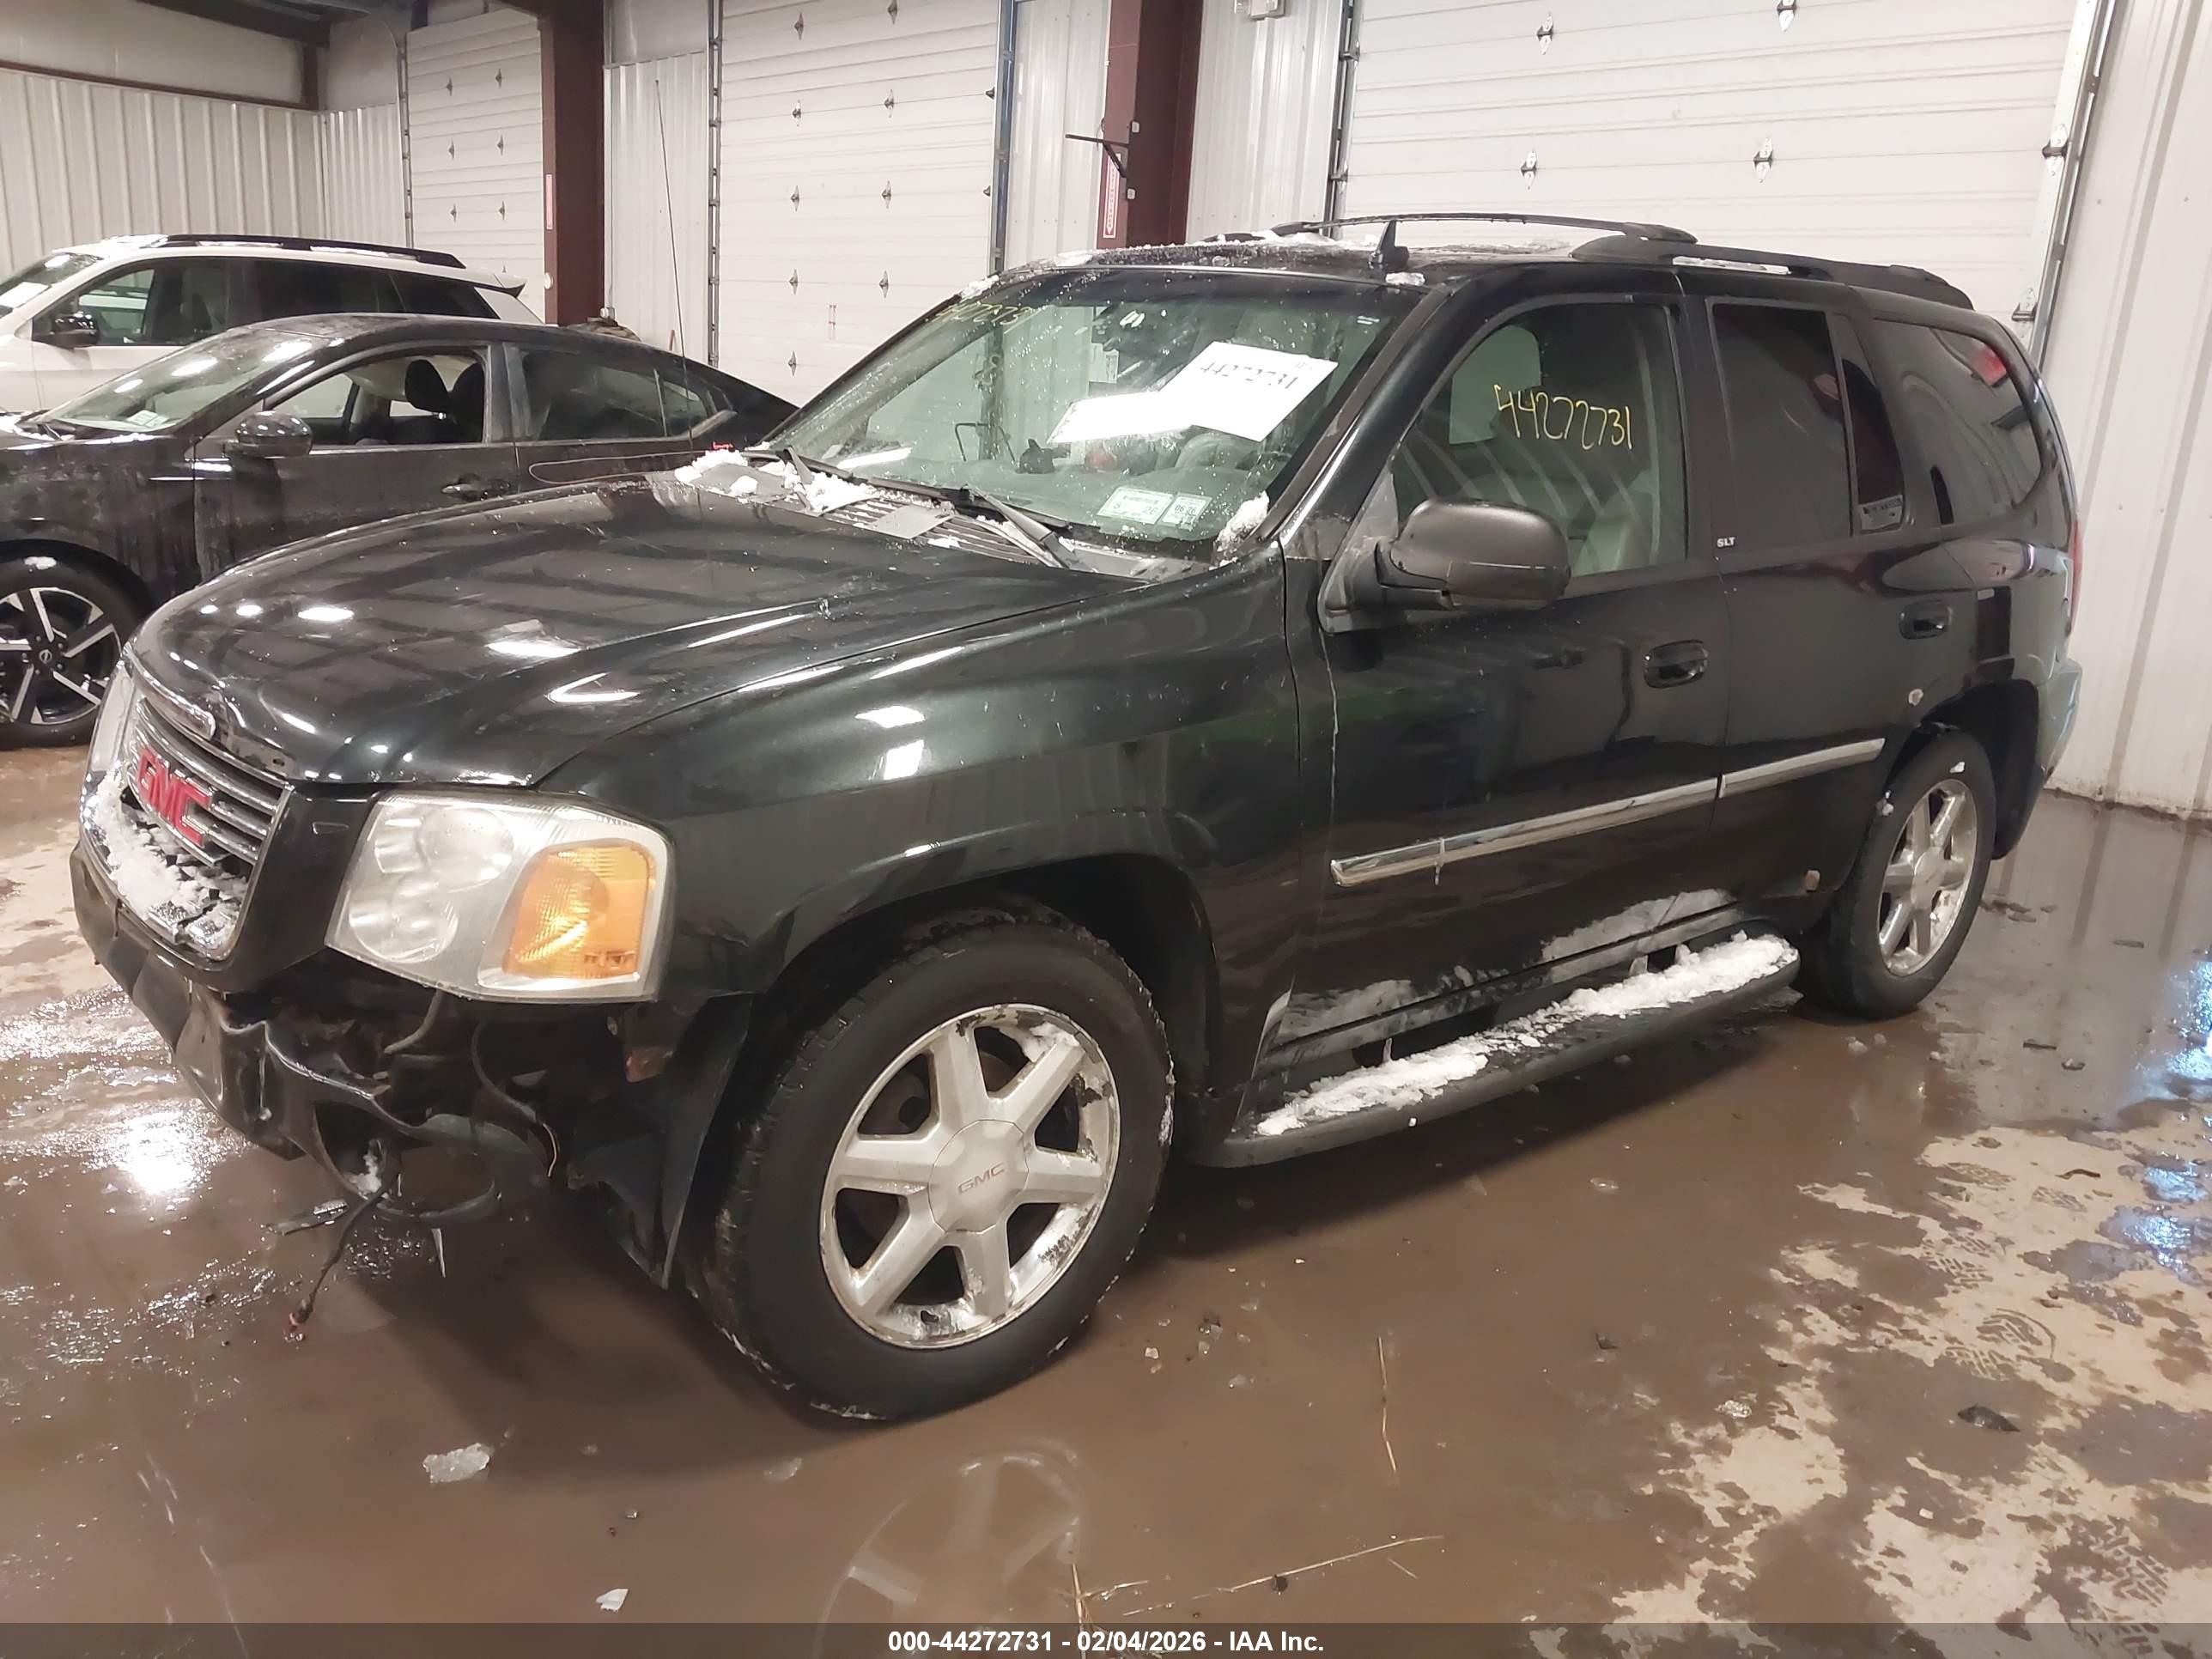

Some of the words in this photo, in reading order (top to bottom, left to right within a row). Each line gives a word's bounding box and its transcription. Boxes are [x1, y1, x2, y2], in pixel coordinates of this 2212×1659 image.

[1493, 384, 1632, 450] 44272731
[1717, 537, 1735, 548] SLT
[137, 744, 212, 848] GMC
[958, 1162, 1005, 1194] GMC
